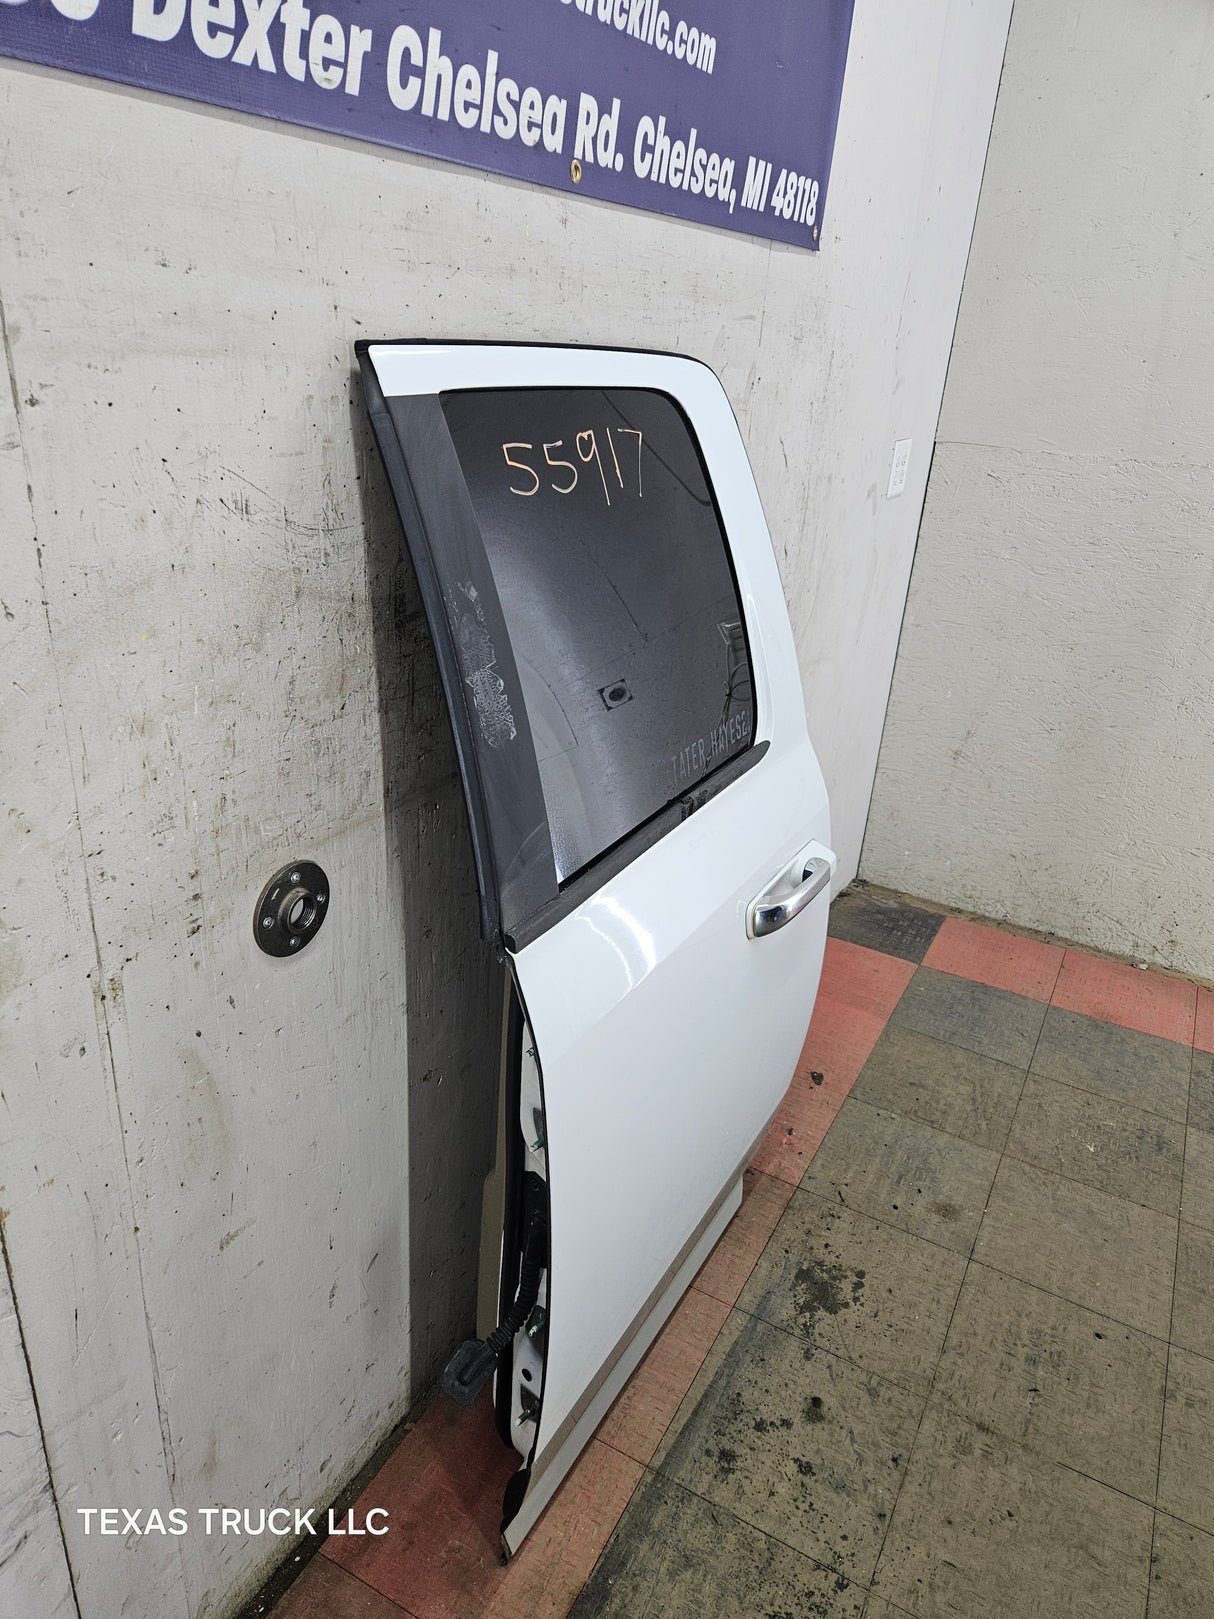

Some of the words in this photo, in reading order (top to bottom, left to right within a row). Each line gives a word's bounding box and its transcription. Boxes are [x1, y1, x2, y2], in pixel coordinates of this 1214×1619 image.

[387, 25, 567, 153] Chelsea
[574, 91, 624, 171] Rd.
[634, 115, 737, 213] Chelsea,
[741, 156, 773, 212] MI
[770, 168, 820, 226] 48118
[502, 427, 643, 506] 55917
